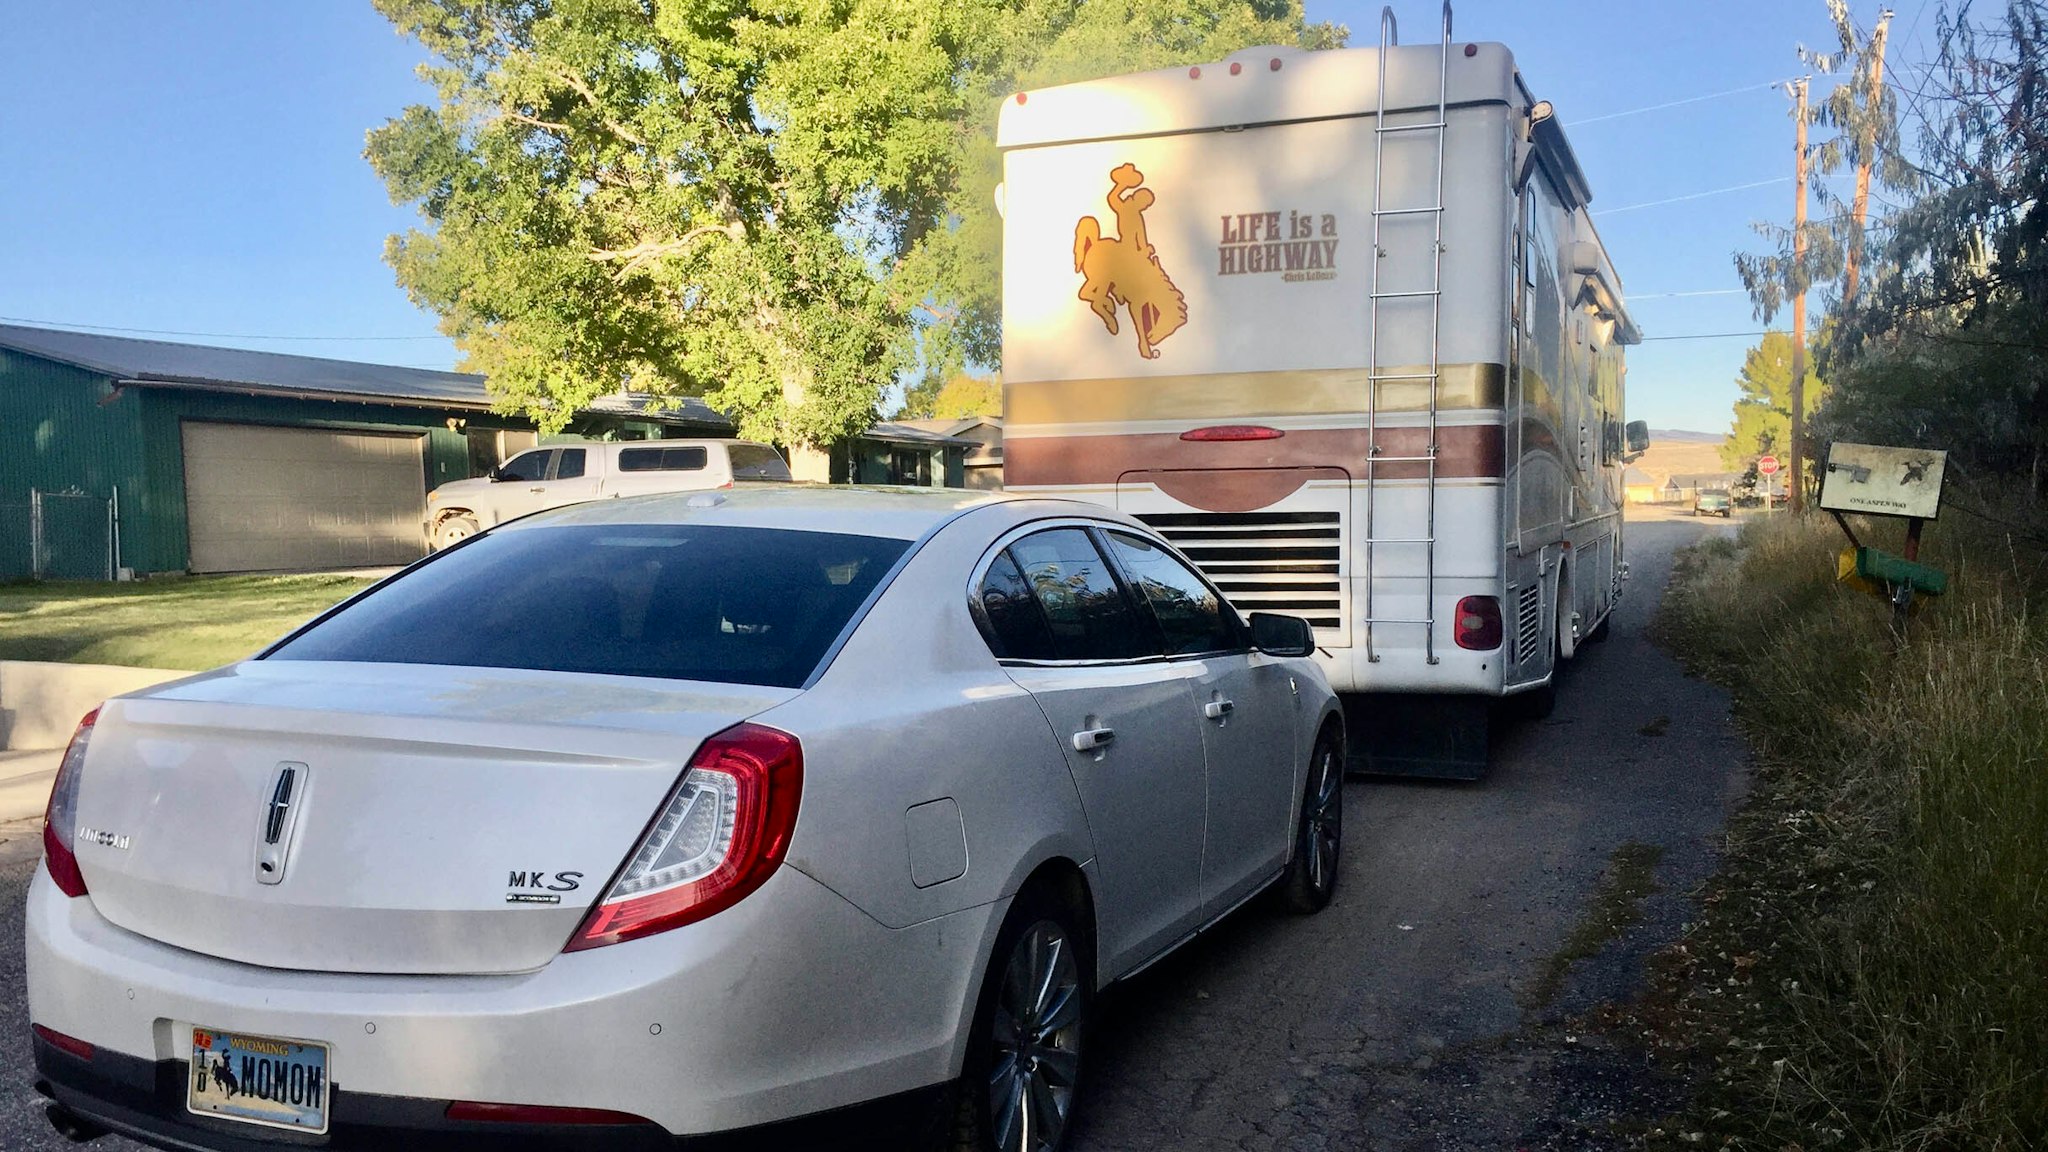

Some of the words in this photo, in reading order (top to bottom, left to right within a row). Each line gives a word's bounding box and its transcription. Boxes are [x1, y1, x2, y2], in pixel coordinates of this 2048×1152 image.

[1220, 211, 1282, 244] LIFE
[1290, 209, 1313, 239] is
[1320, 213, 1338, 237] a
[1218, 239, 1339, 276] HIGHWAY
[1759, 461, 1779, 470] STOP
[1849, 497, 1865, 505] ONE
[508, 870, 584, 892] MKS
[230, 1036, 289, 1056] WYOMING
[241, 1055, 321, 1109] MOMOM
